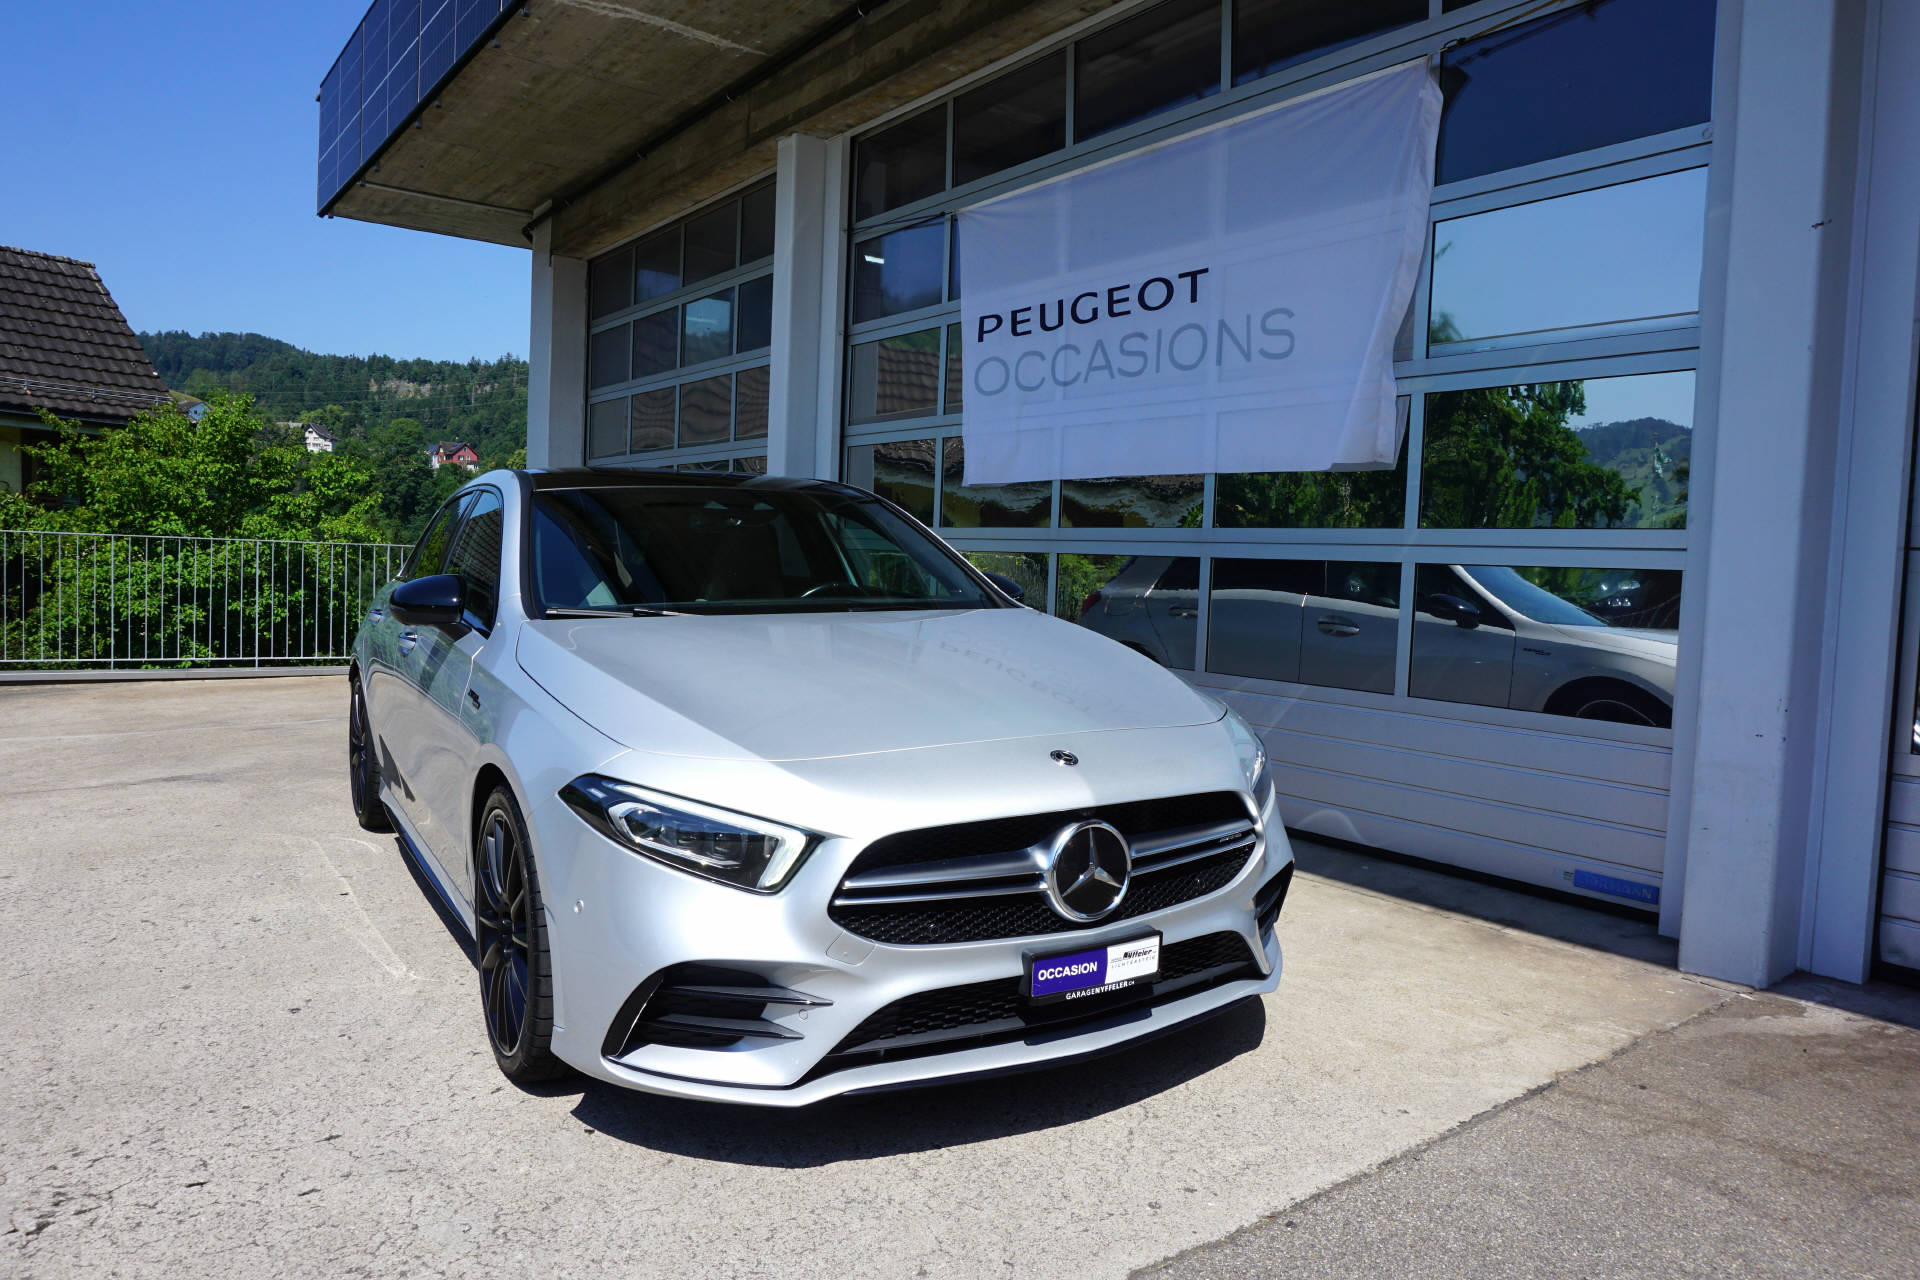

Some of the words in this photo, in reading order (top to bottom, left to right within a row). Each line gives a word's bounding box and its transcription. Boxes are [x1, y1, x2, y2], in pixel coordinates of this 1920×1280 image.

[977, 267, 1209, 342] PEUGEOT
[974, 308, 1296, 396] OCCASIONS
[1038, 962, 1098, 981] OCCASION
